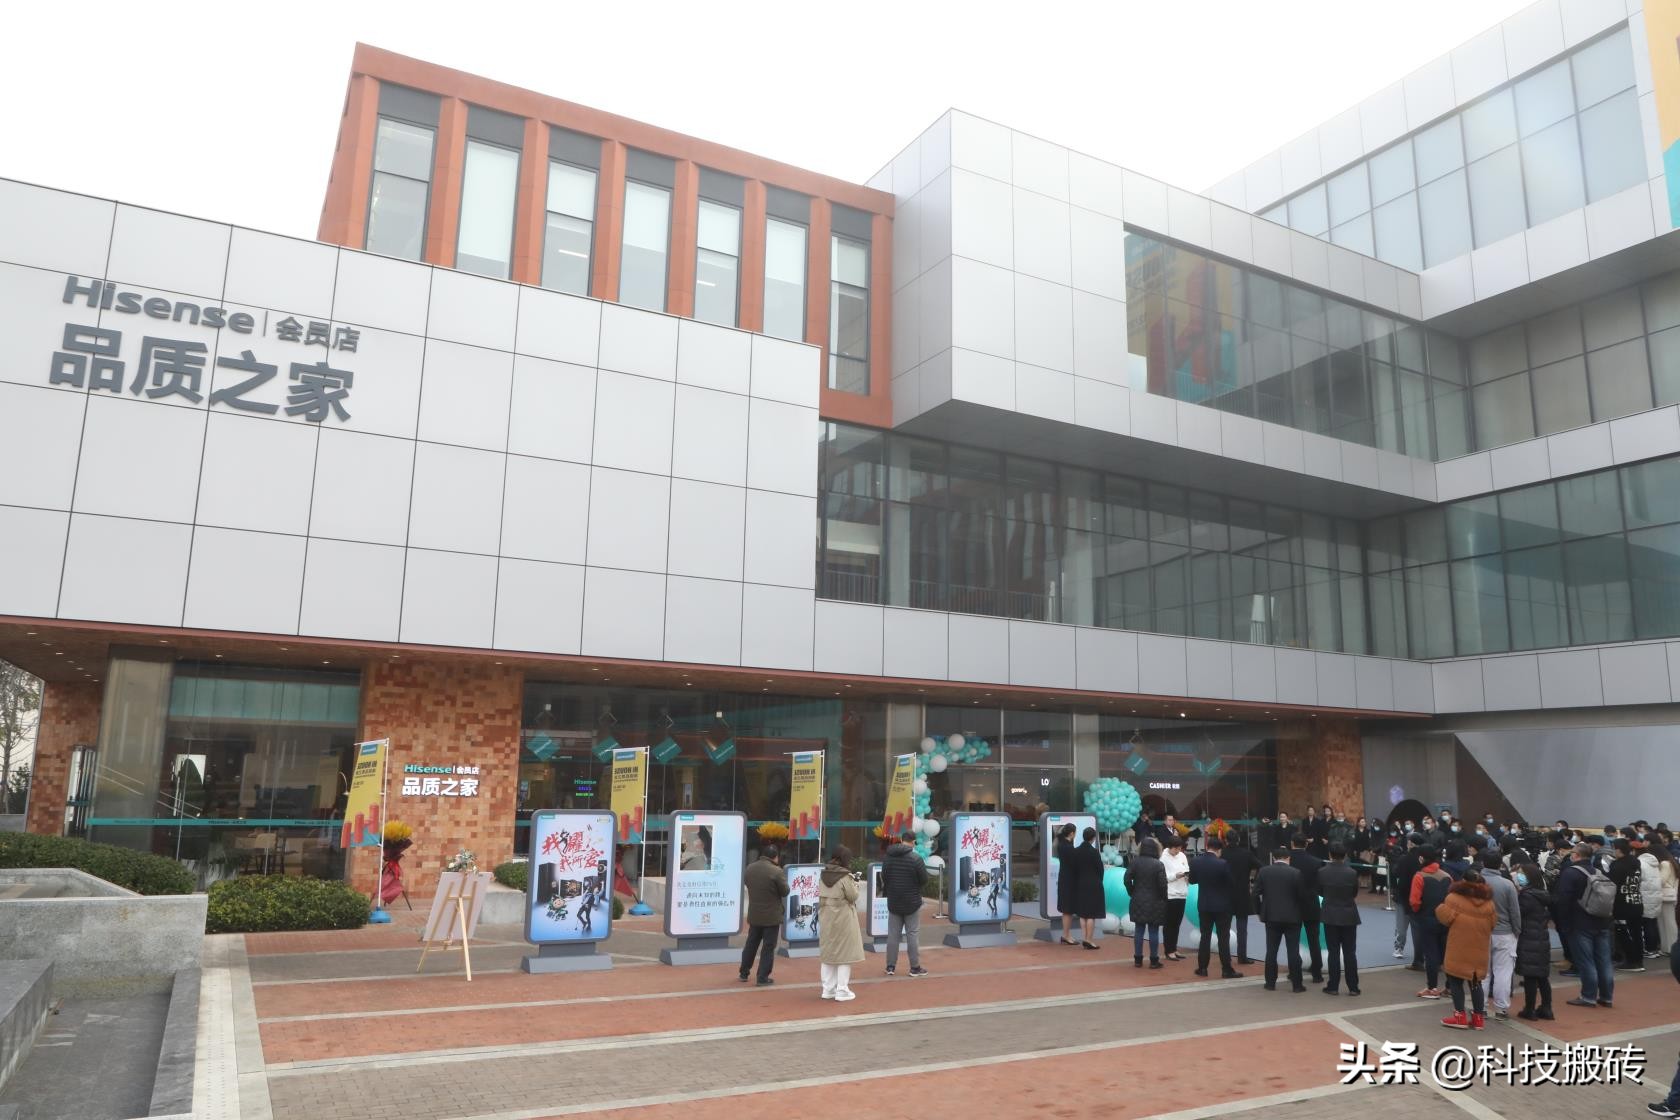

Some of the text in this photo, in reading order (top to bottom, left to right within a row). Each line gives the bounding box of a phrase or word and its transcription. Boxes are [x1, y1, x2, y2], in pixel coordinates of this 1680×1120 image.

[62, 275, 361, 353] Hisense 会员店
[50, 322, 354, 422] 品质之家
[402, 777, 479, 797] 品质之家
[404, 764, 480, 775] Hisense 会员店
